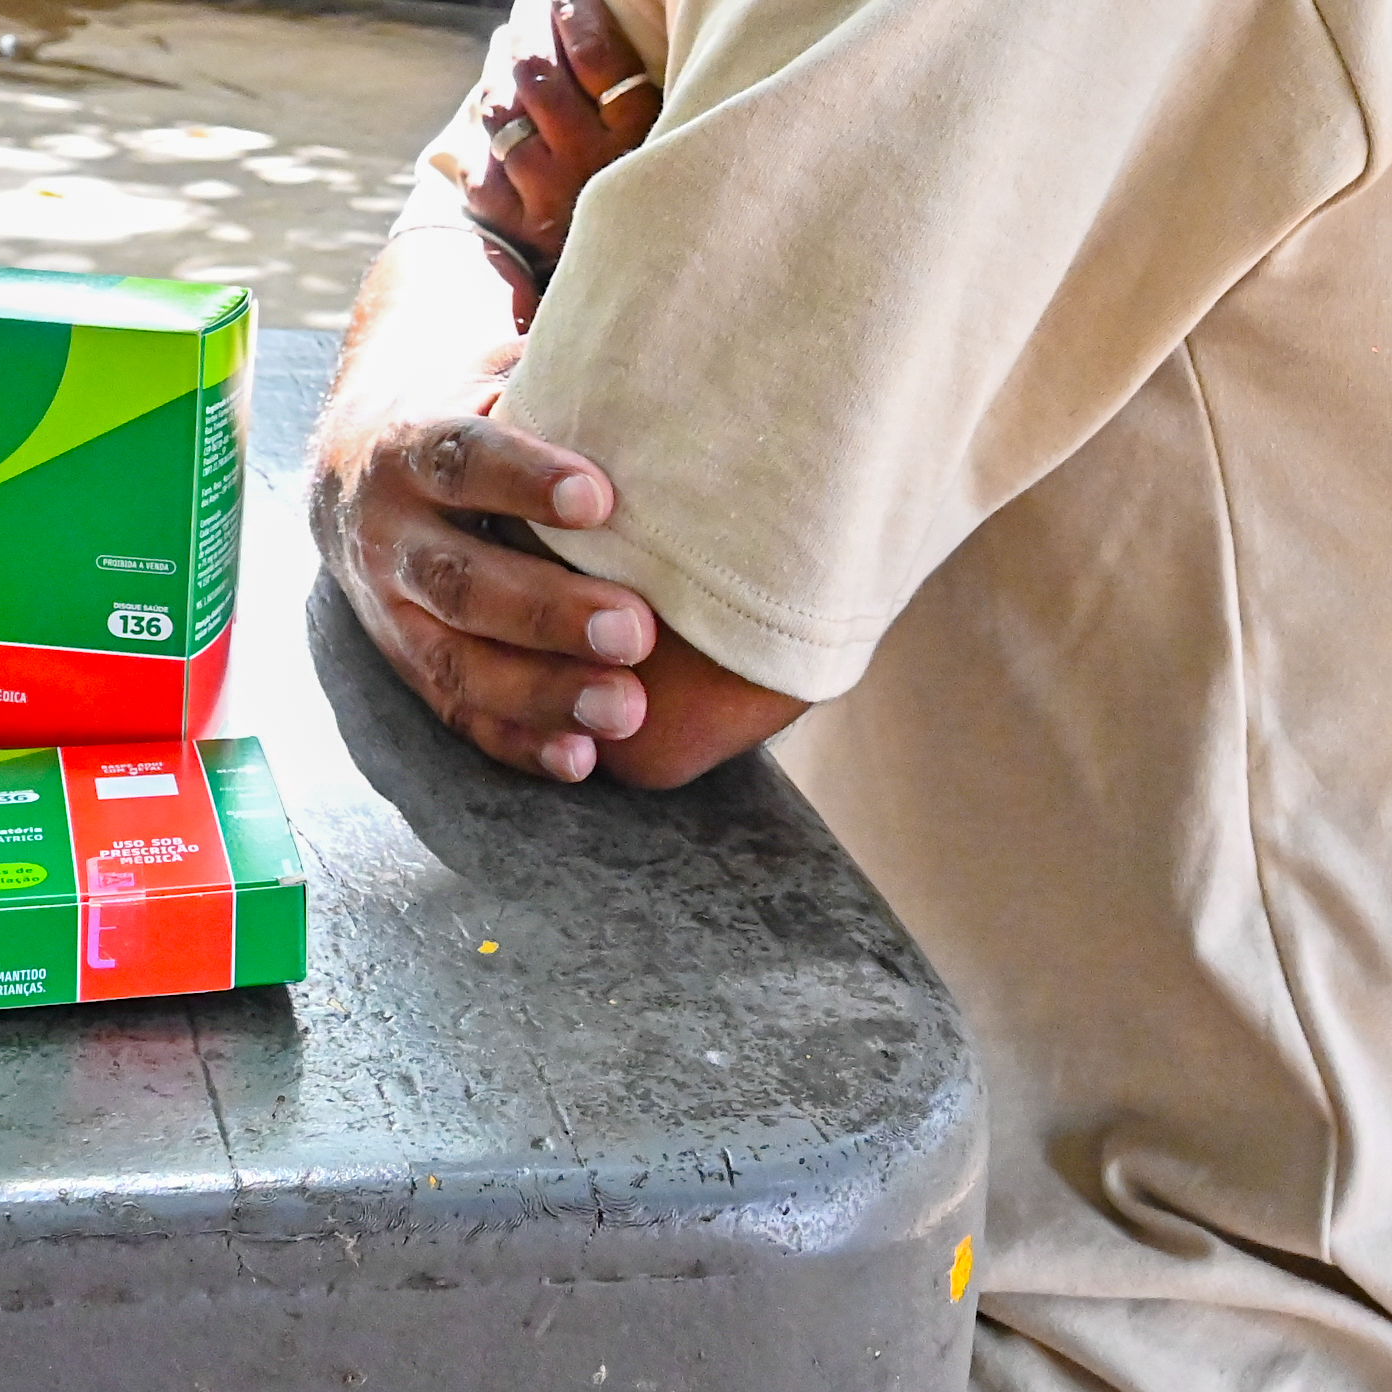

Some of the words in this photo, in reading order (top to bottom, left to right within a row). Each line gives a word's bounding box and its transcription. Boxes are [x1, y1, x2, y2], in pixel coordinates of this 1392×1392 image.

[103, 558, 137, 568] PROIBIDA
[146, 562, 169, 571] VENDA
[119, 615, 162, 637] 136
[113, 839, 145, 849] USO
[151, 837, 183, 846] SOB
[99, 844, 200, 858] PRESCRIÇÃO
[16, 867, 33, 875] de
